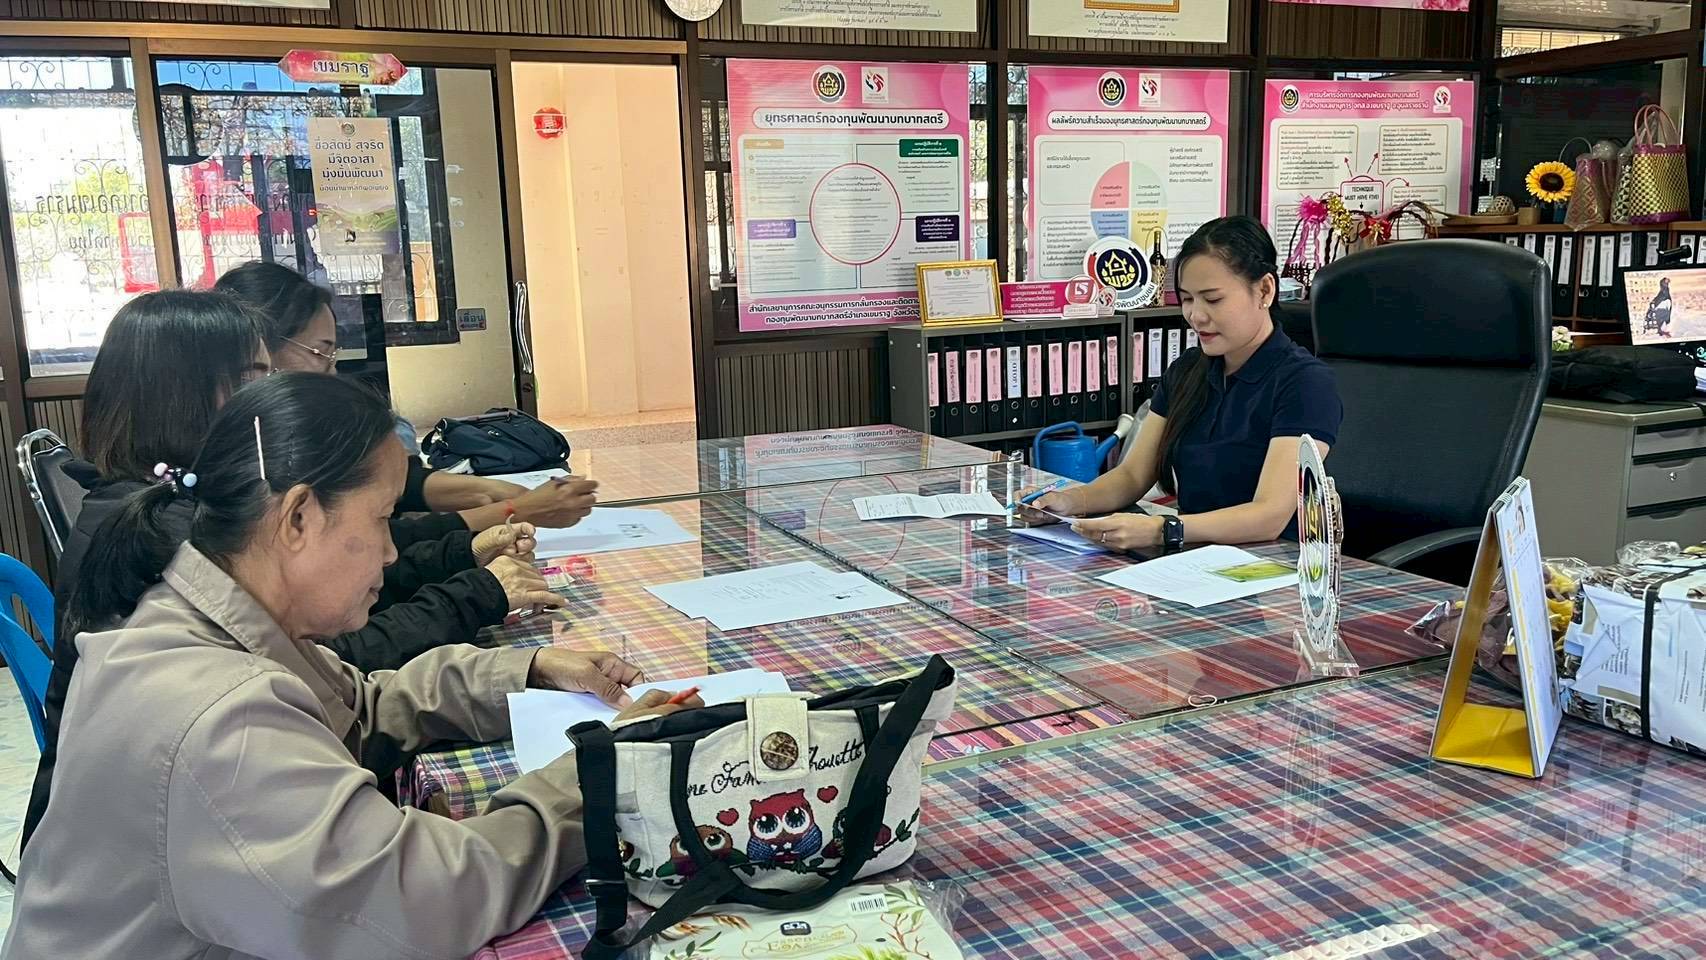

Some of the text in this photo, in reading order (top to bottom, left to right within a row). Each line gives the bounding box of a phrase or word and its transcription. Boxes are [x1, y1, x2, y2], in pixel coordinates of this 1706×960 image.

[312, 59, 370, 78] เขมราฐ
[764, 112, 944, 128] ยุทธศาสตร์กองทุนพัฒนาบทบาทสตรี
[355, 138, 385, 153] สุจริต
[328, 154, 375, 166] มีจิตอาสา
[322, 164, 384, 181] มุ่งมั่นพัฒนา
[1114, 283, 1155, 309] รพัฒนาชุมชน
[711, 760, 767, 795] Fam
[808, 738, 867, 771] houette
